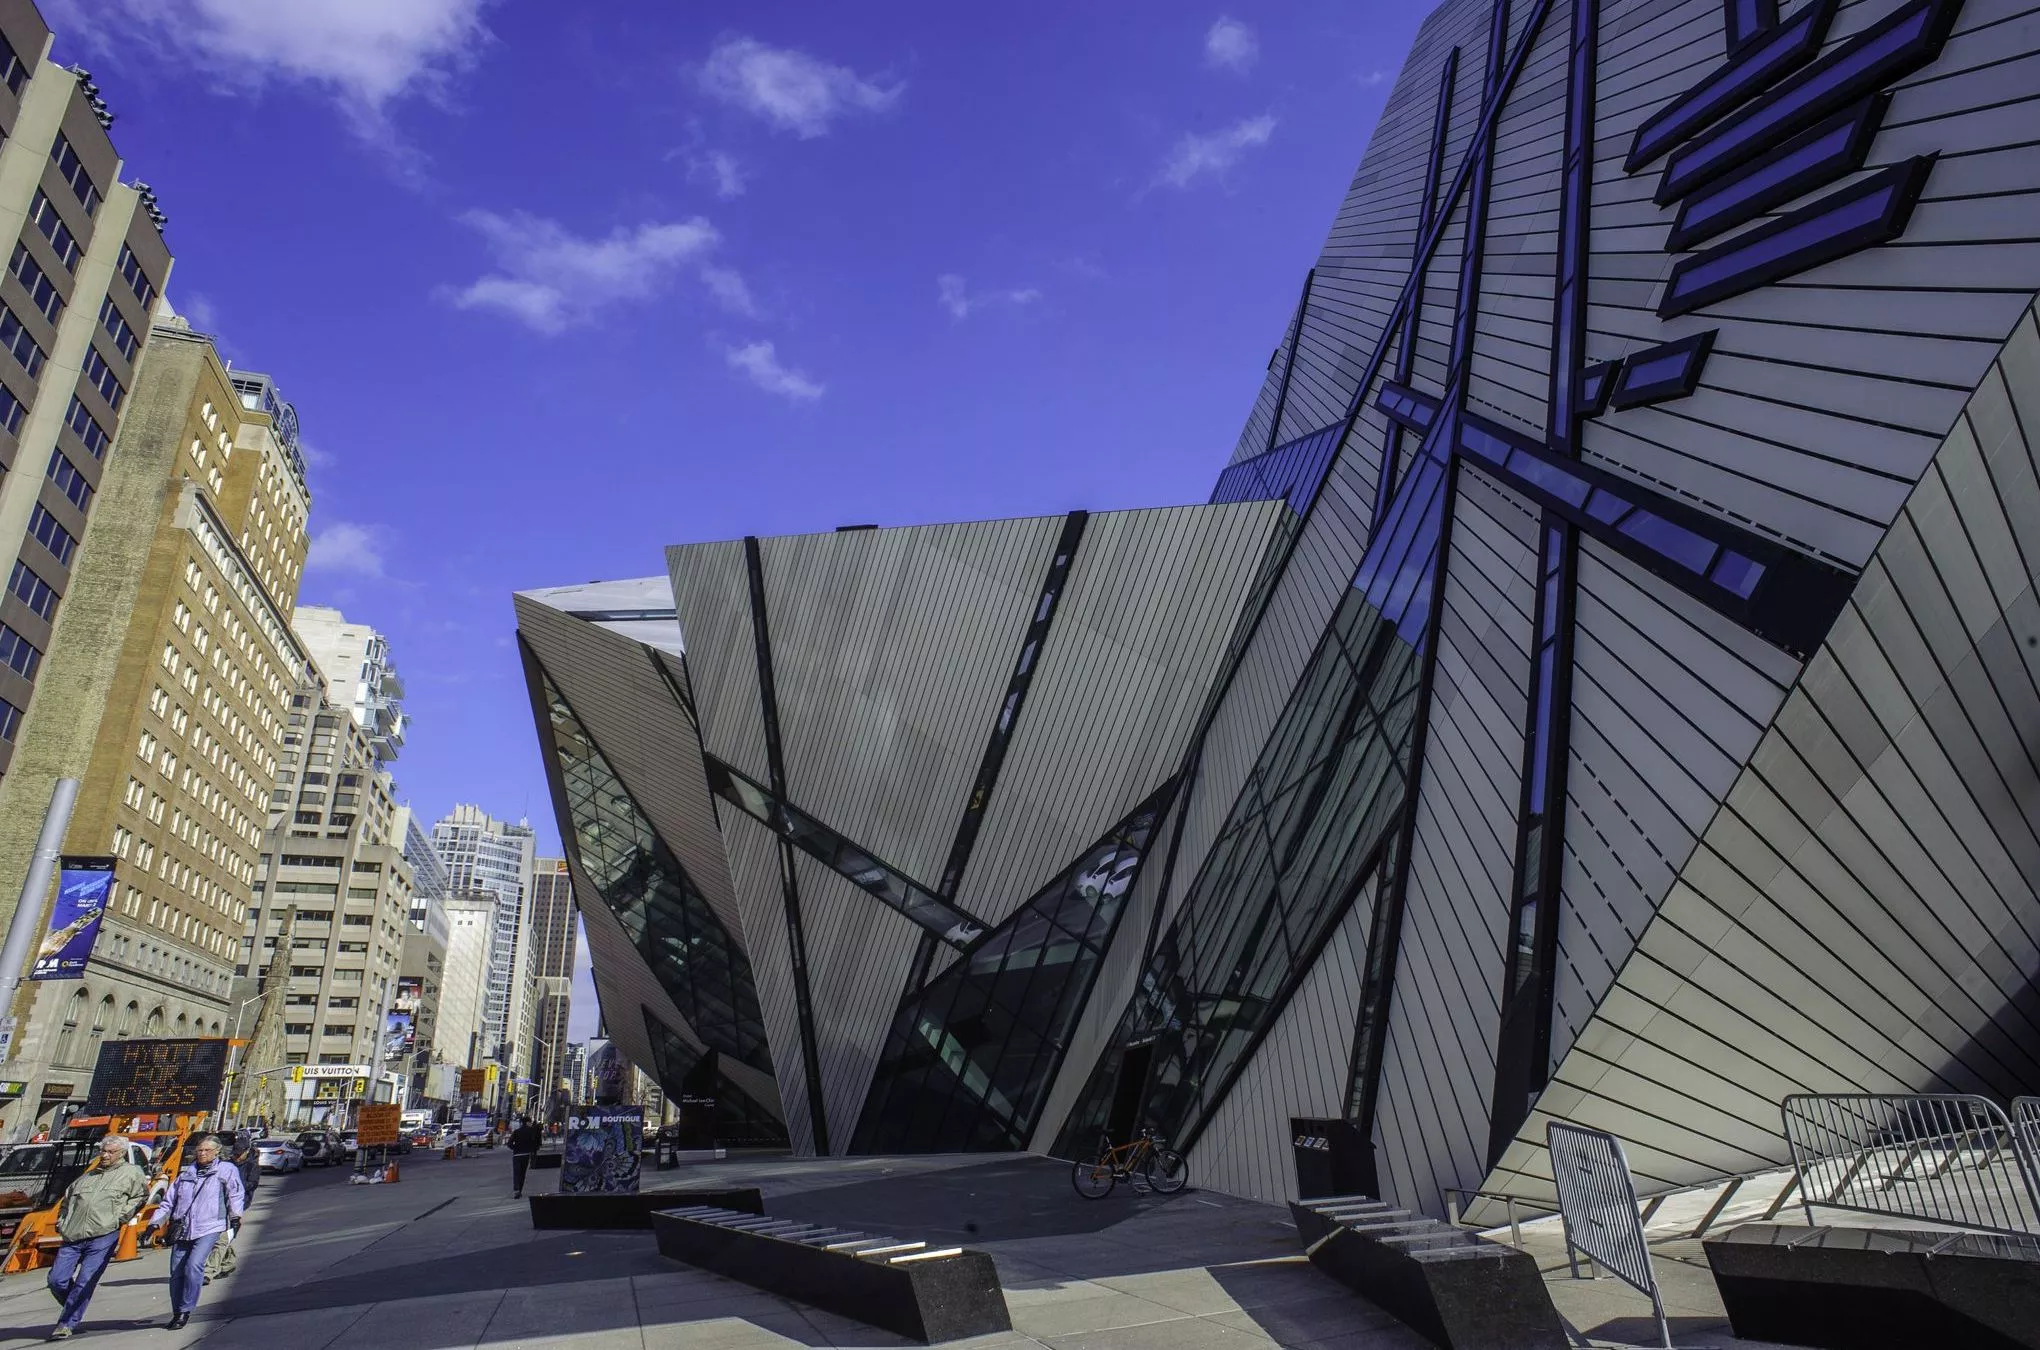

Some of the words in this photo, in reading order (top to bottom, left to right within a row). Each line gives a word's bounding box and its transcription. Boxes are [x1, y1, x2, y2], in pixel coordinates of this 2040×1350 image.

[124, 1043, 198, 1063] HYATT
[133, 1065, 178, 1085] FOR
[322, 1067, 360, 1075] VUITTON
[105, 1085, 198, 1106] ACCESS
